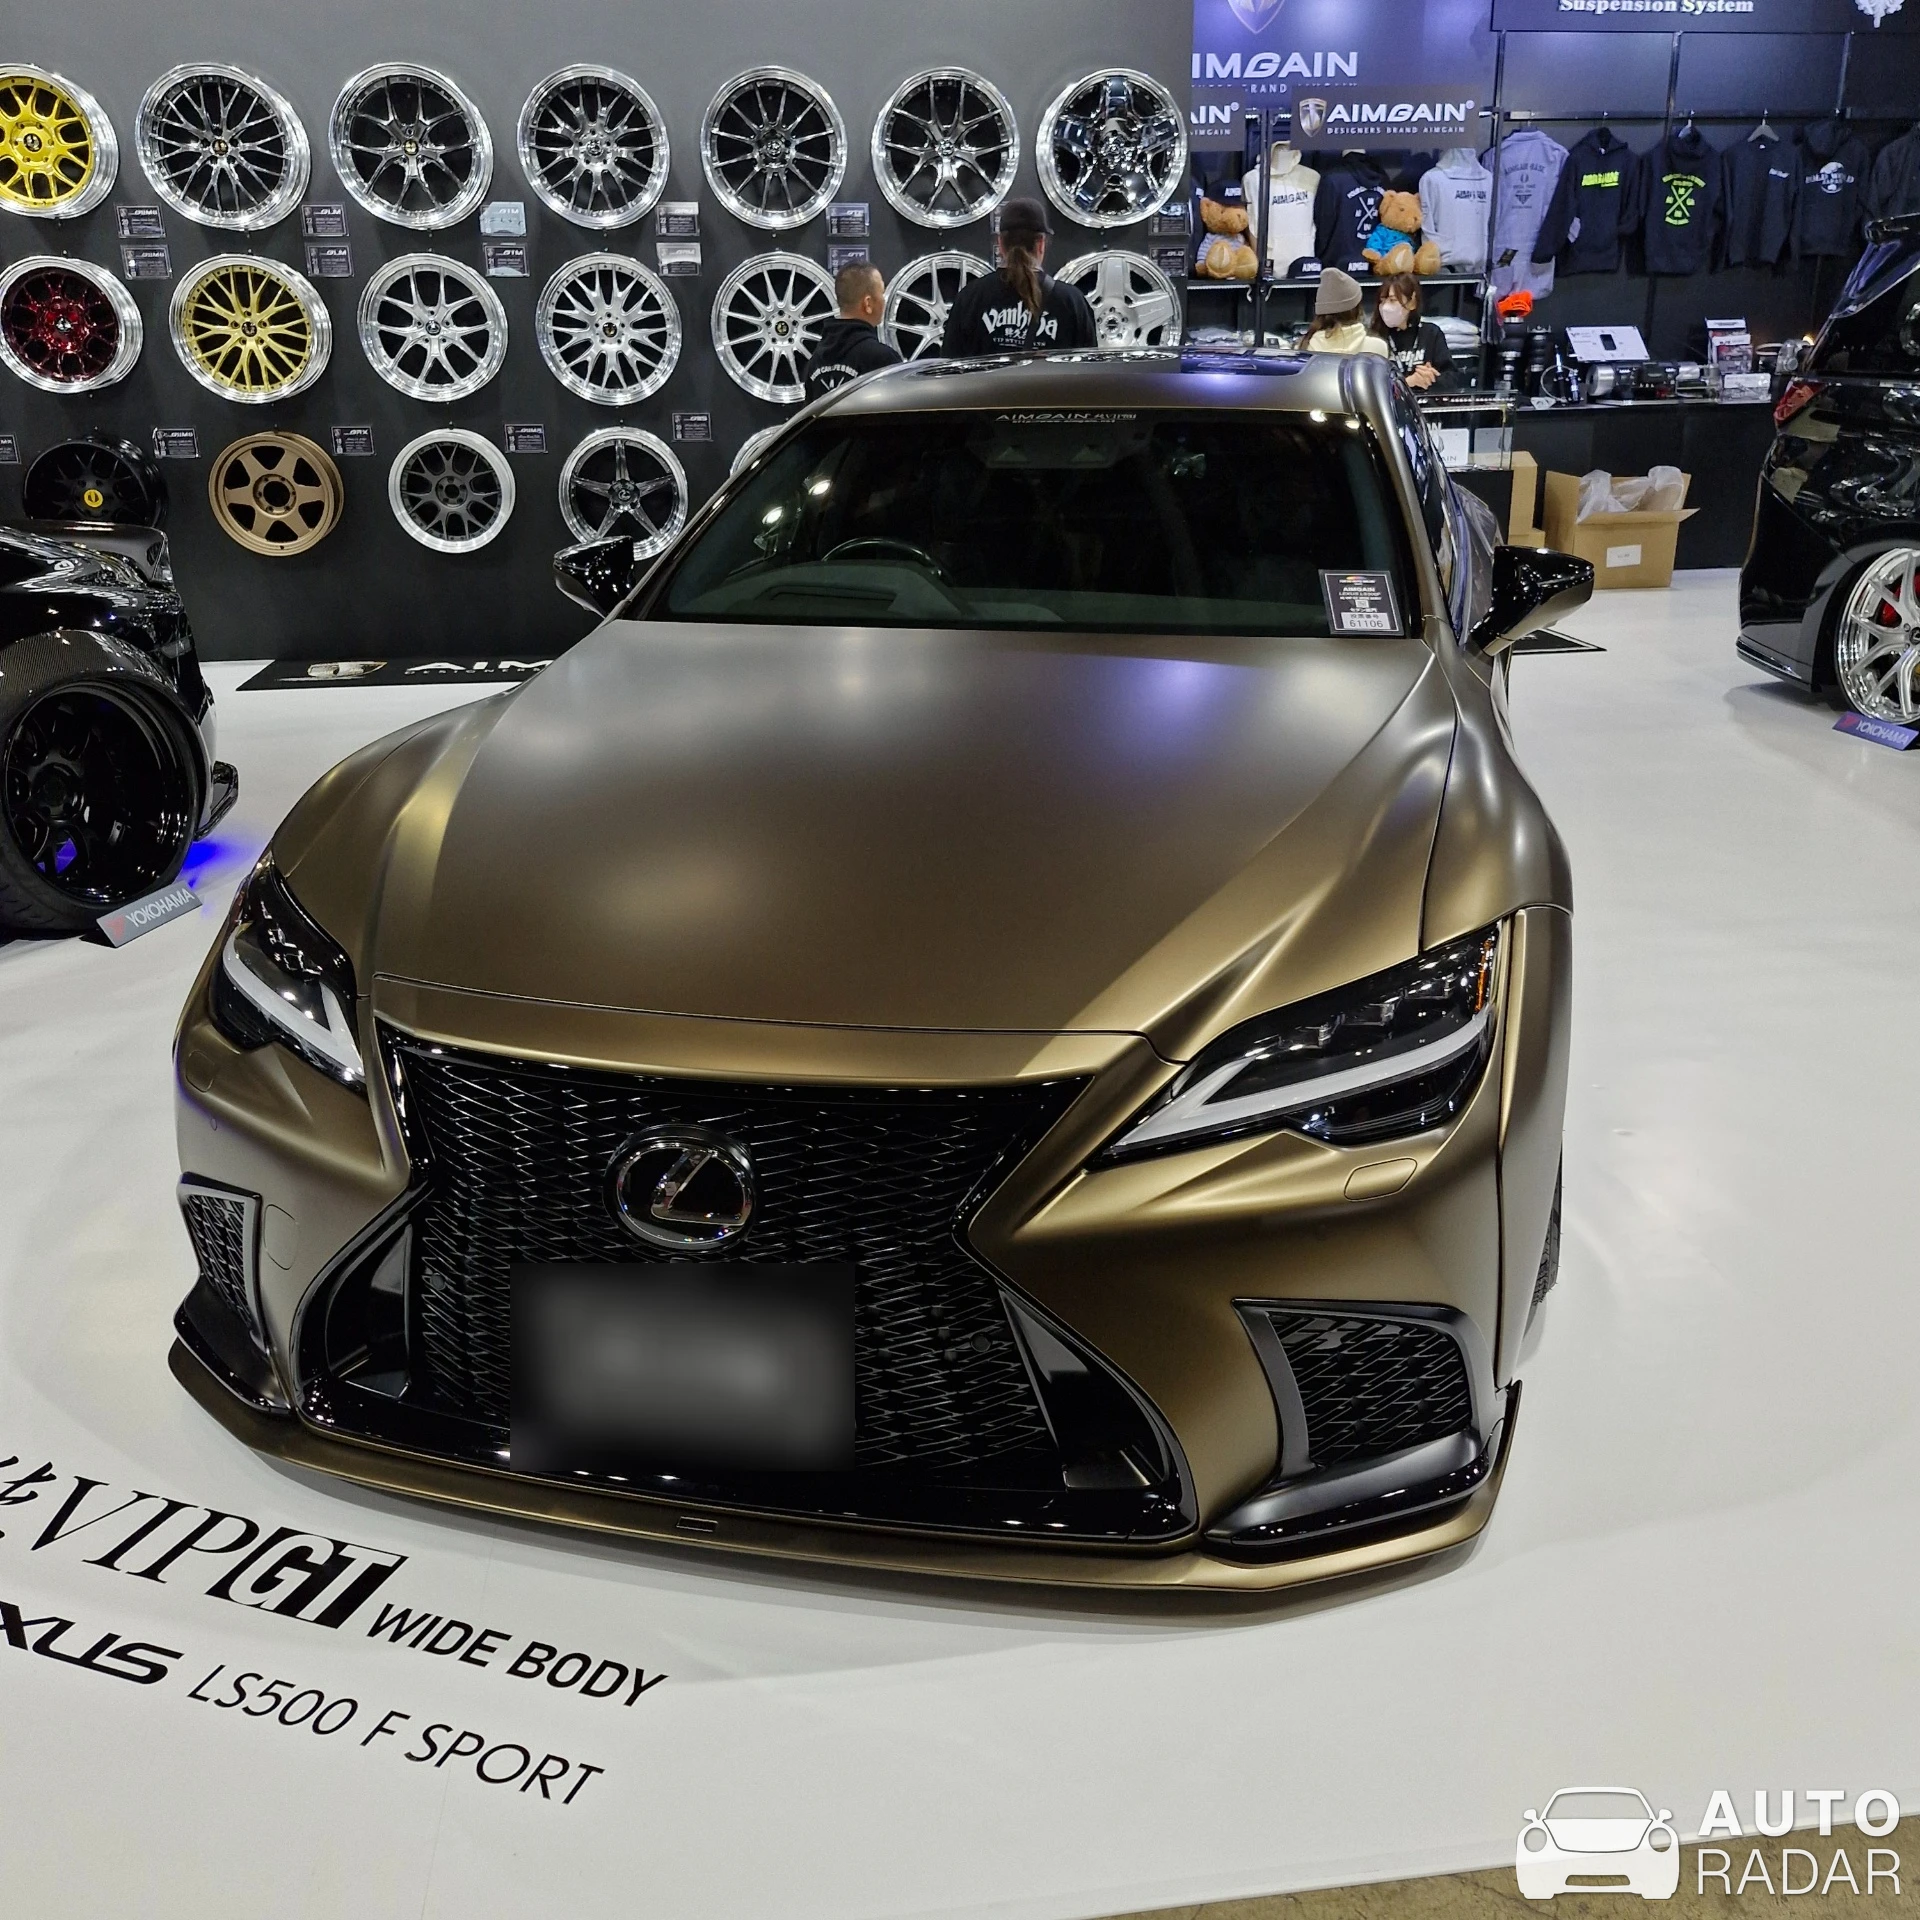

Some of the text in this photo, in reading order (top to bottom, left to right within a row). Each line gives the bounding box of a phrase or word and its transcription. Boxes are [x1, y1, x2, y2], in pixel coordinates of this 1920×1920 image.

[1559, 0, 1754, 15] Suspension System
[1191, 52, 1358, 79] IMGAIN
[1247, 84, 1288, 94] RAND
[1327, 103, 1467, 122] AIMGAIN
[1327, 126, 1465, 135] DESIGNERS BRAND AIMGAIN
[1349, 620, 1384, 628] 61106
[1856, 720, 1910, 745] YOKOHAMA
[125, 888, 195, 927] YOKOHAMA
[366, 1603, 512, 1668] WIDE
[506, 1640, 669, 1707] BODY
[0, 1601, 605, 1805] XUS LS500 F SPORT
